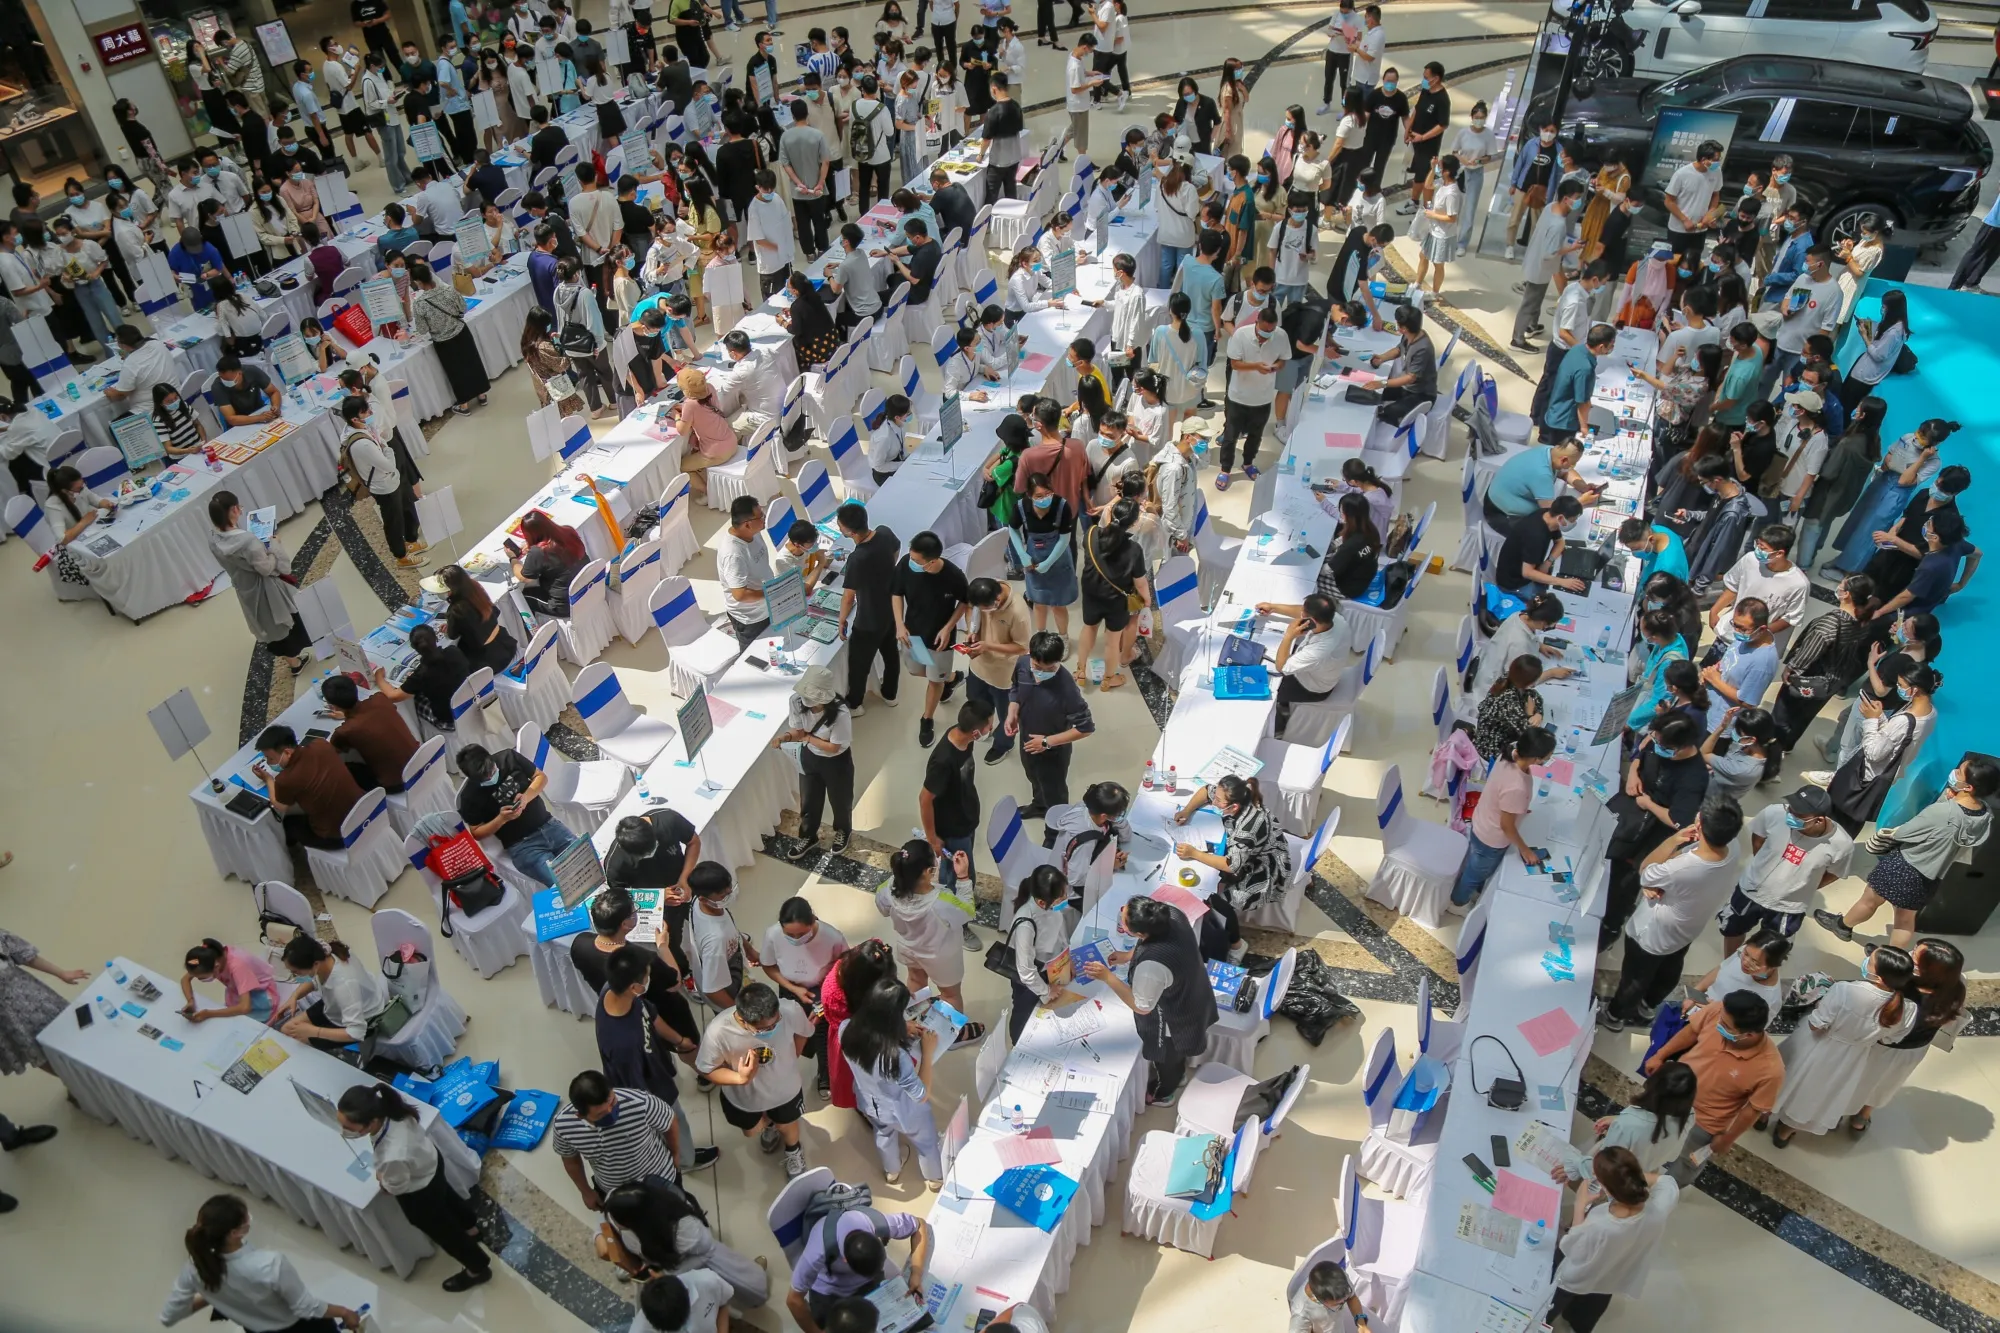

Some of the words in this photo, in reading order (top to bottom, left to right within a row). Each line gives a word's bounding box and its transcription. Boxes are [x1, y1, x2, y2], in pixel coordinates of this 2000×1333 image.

[102, 29, 142, 51] 周大福
[109, 54, 124, 62] CHOW
[132, 47, 147, 55] FOOK
[1783, 851, 1800, 863] 李宁
[1787, 844, 1804, 857] 中国
[633, 891, 655, 902] 招聘
[926, 1283, 948, 1315] 招聘
